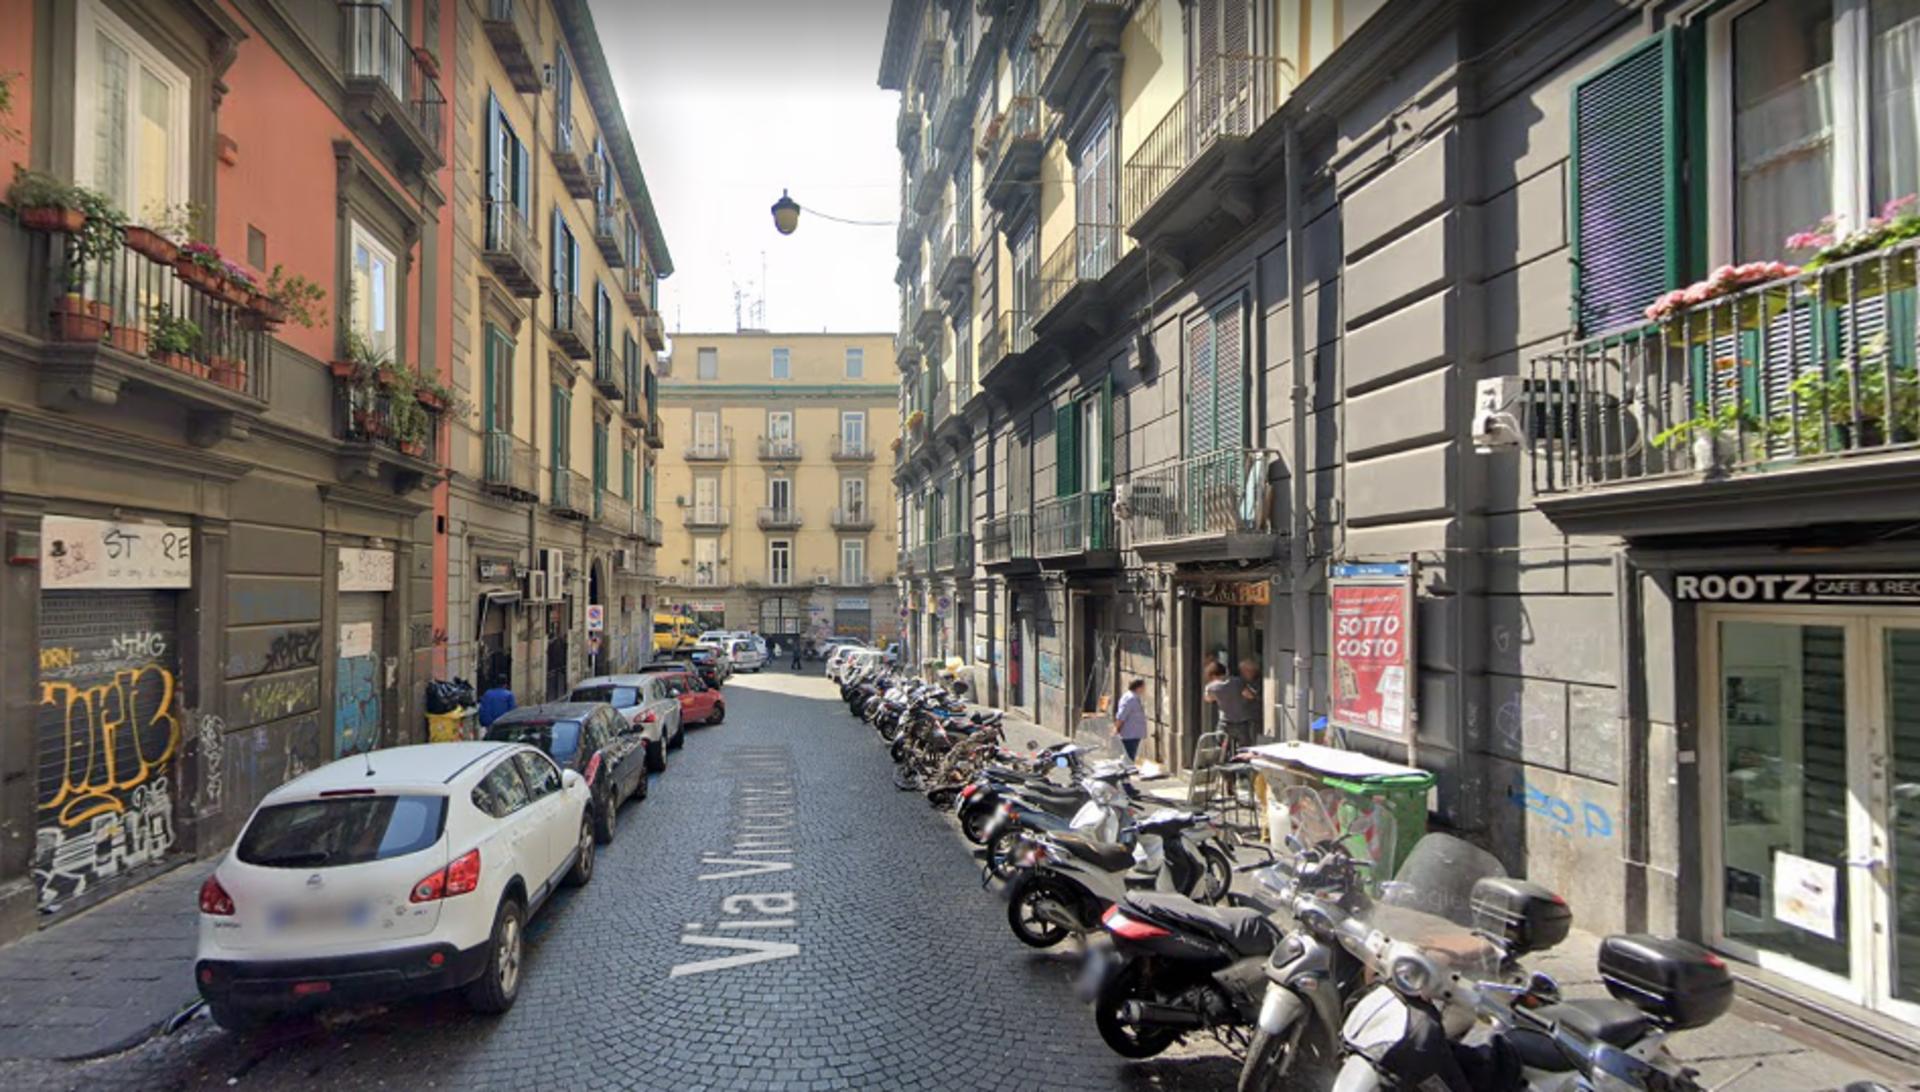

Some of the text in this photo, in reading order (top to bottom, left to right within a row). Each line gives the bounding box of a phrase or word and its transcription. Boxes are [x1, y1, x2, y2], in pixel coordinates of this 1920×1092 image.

[1675, 574, 1812, 601] ROOTZ
[1865, 580, 1880, 594] &
[1337, 615, 1400, 637] SOTTO
[1336, 638, 1399, 658] COSTO
